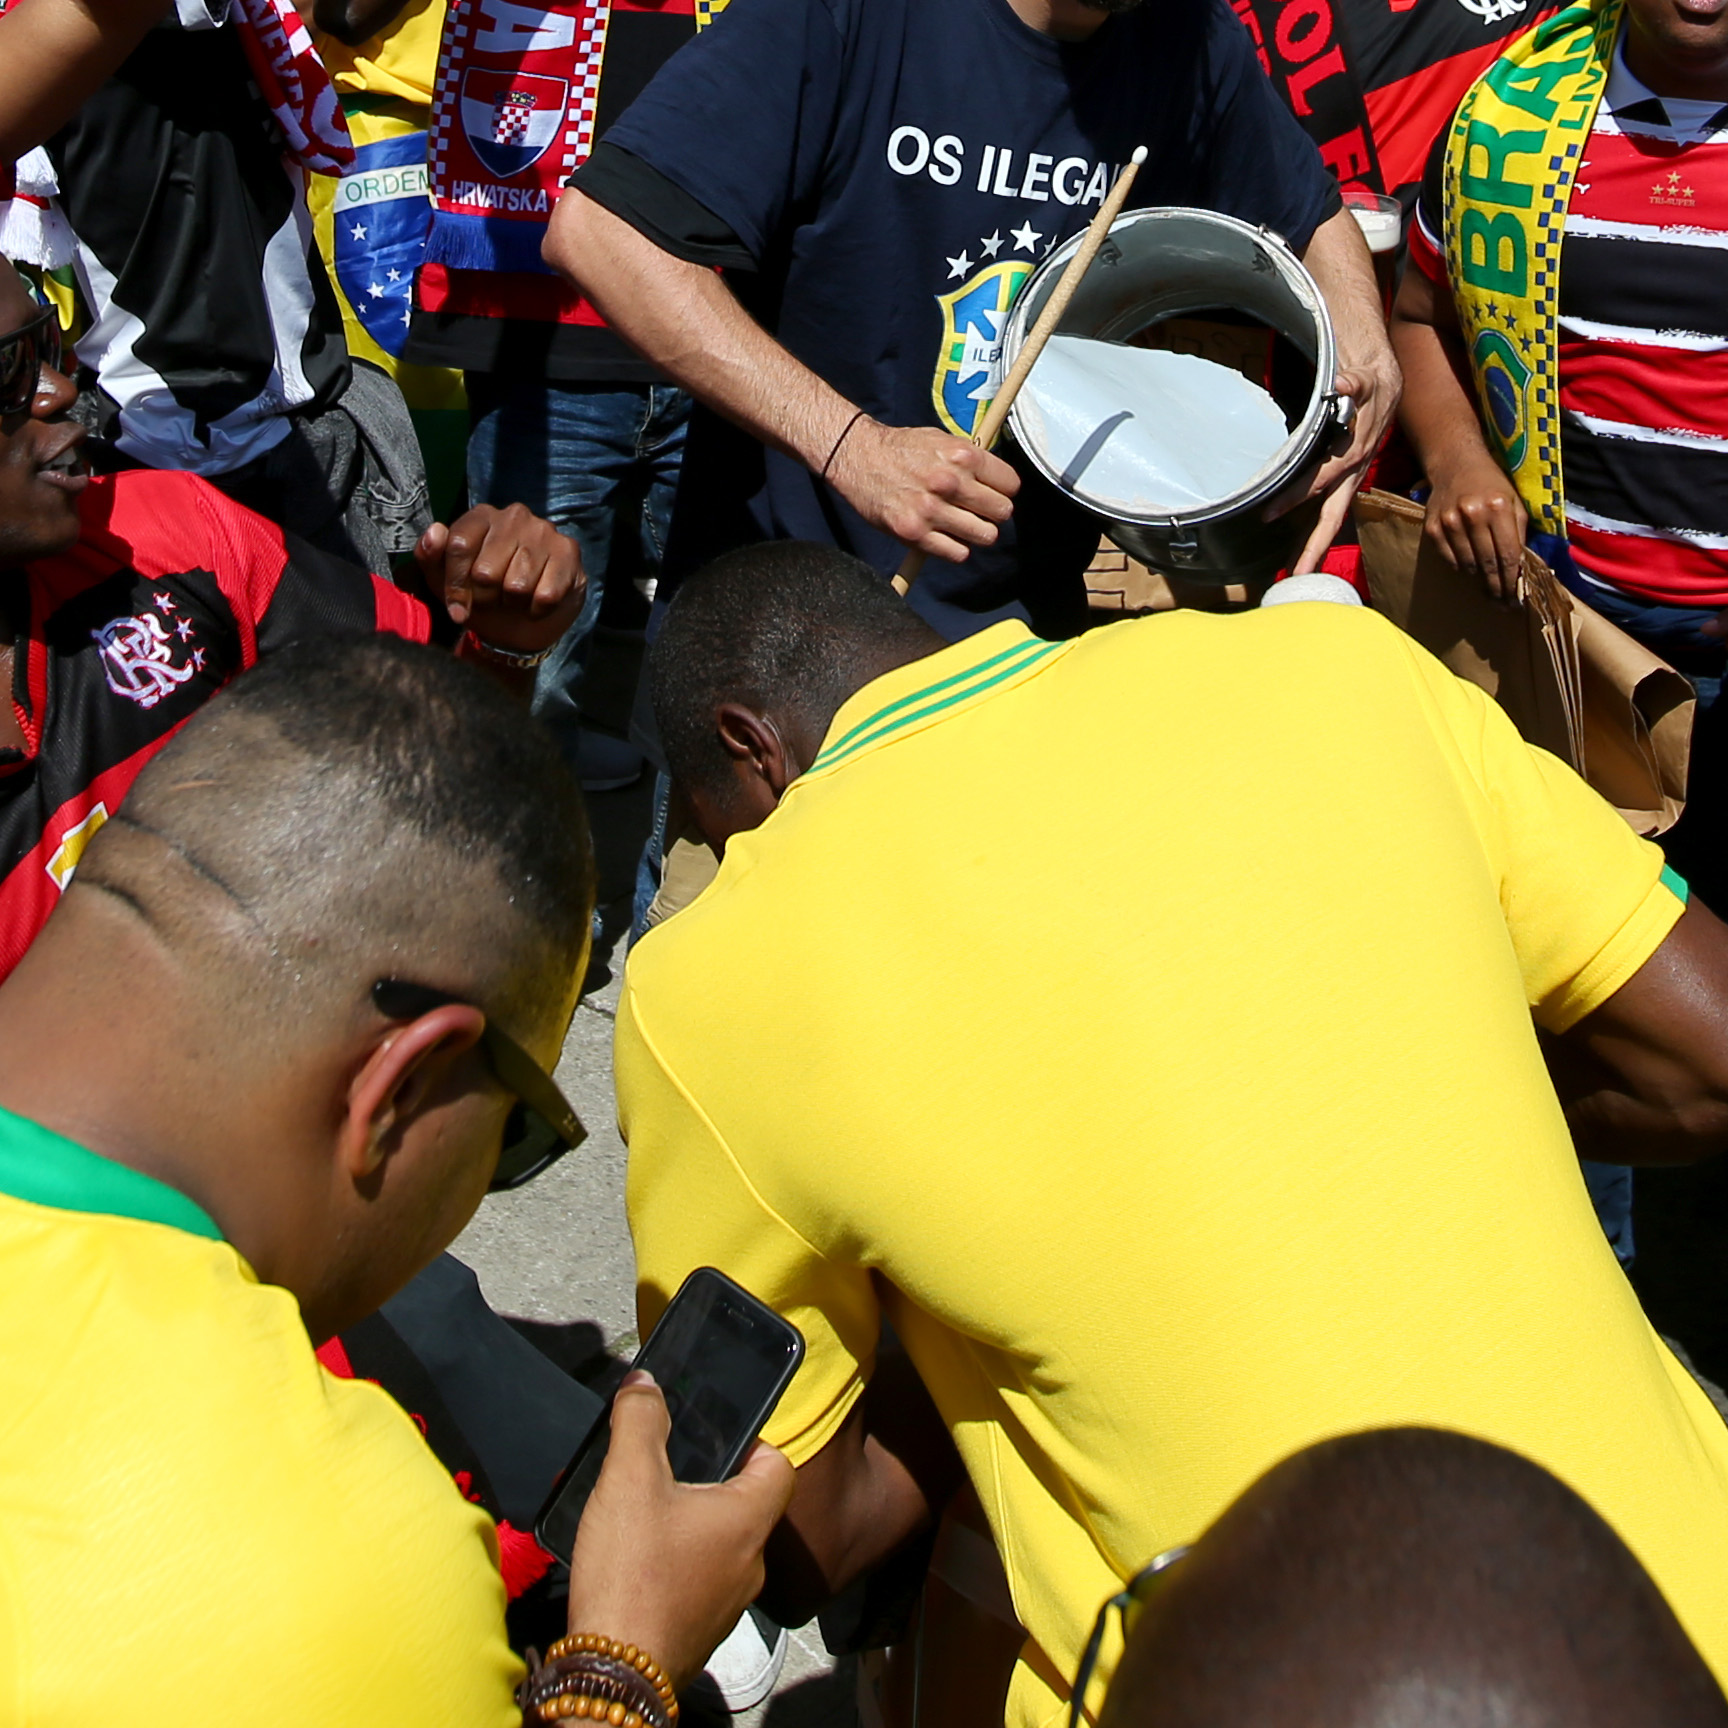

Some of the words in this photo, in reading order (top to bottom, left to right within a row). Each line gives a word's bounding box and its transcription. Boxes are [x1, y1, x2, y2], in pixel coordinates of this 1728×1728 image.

[887, 125, 966, 186] OS
[976, 144, 1132, 207] ILEGAI
[450, 179, 549, 213] HRVATSKA
[1648, 195, 1696, 207] TRI-SUPER
